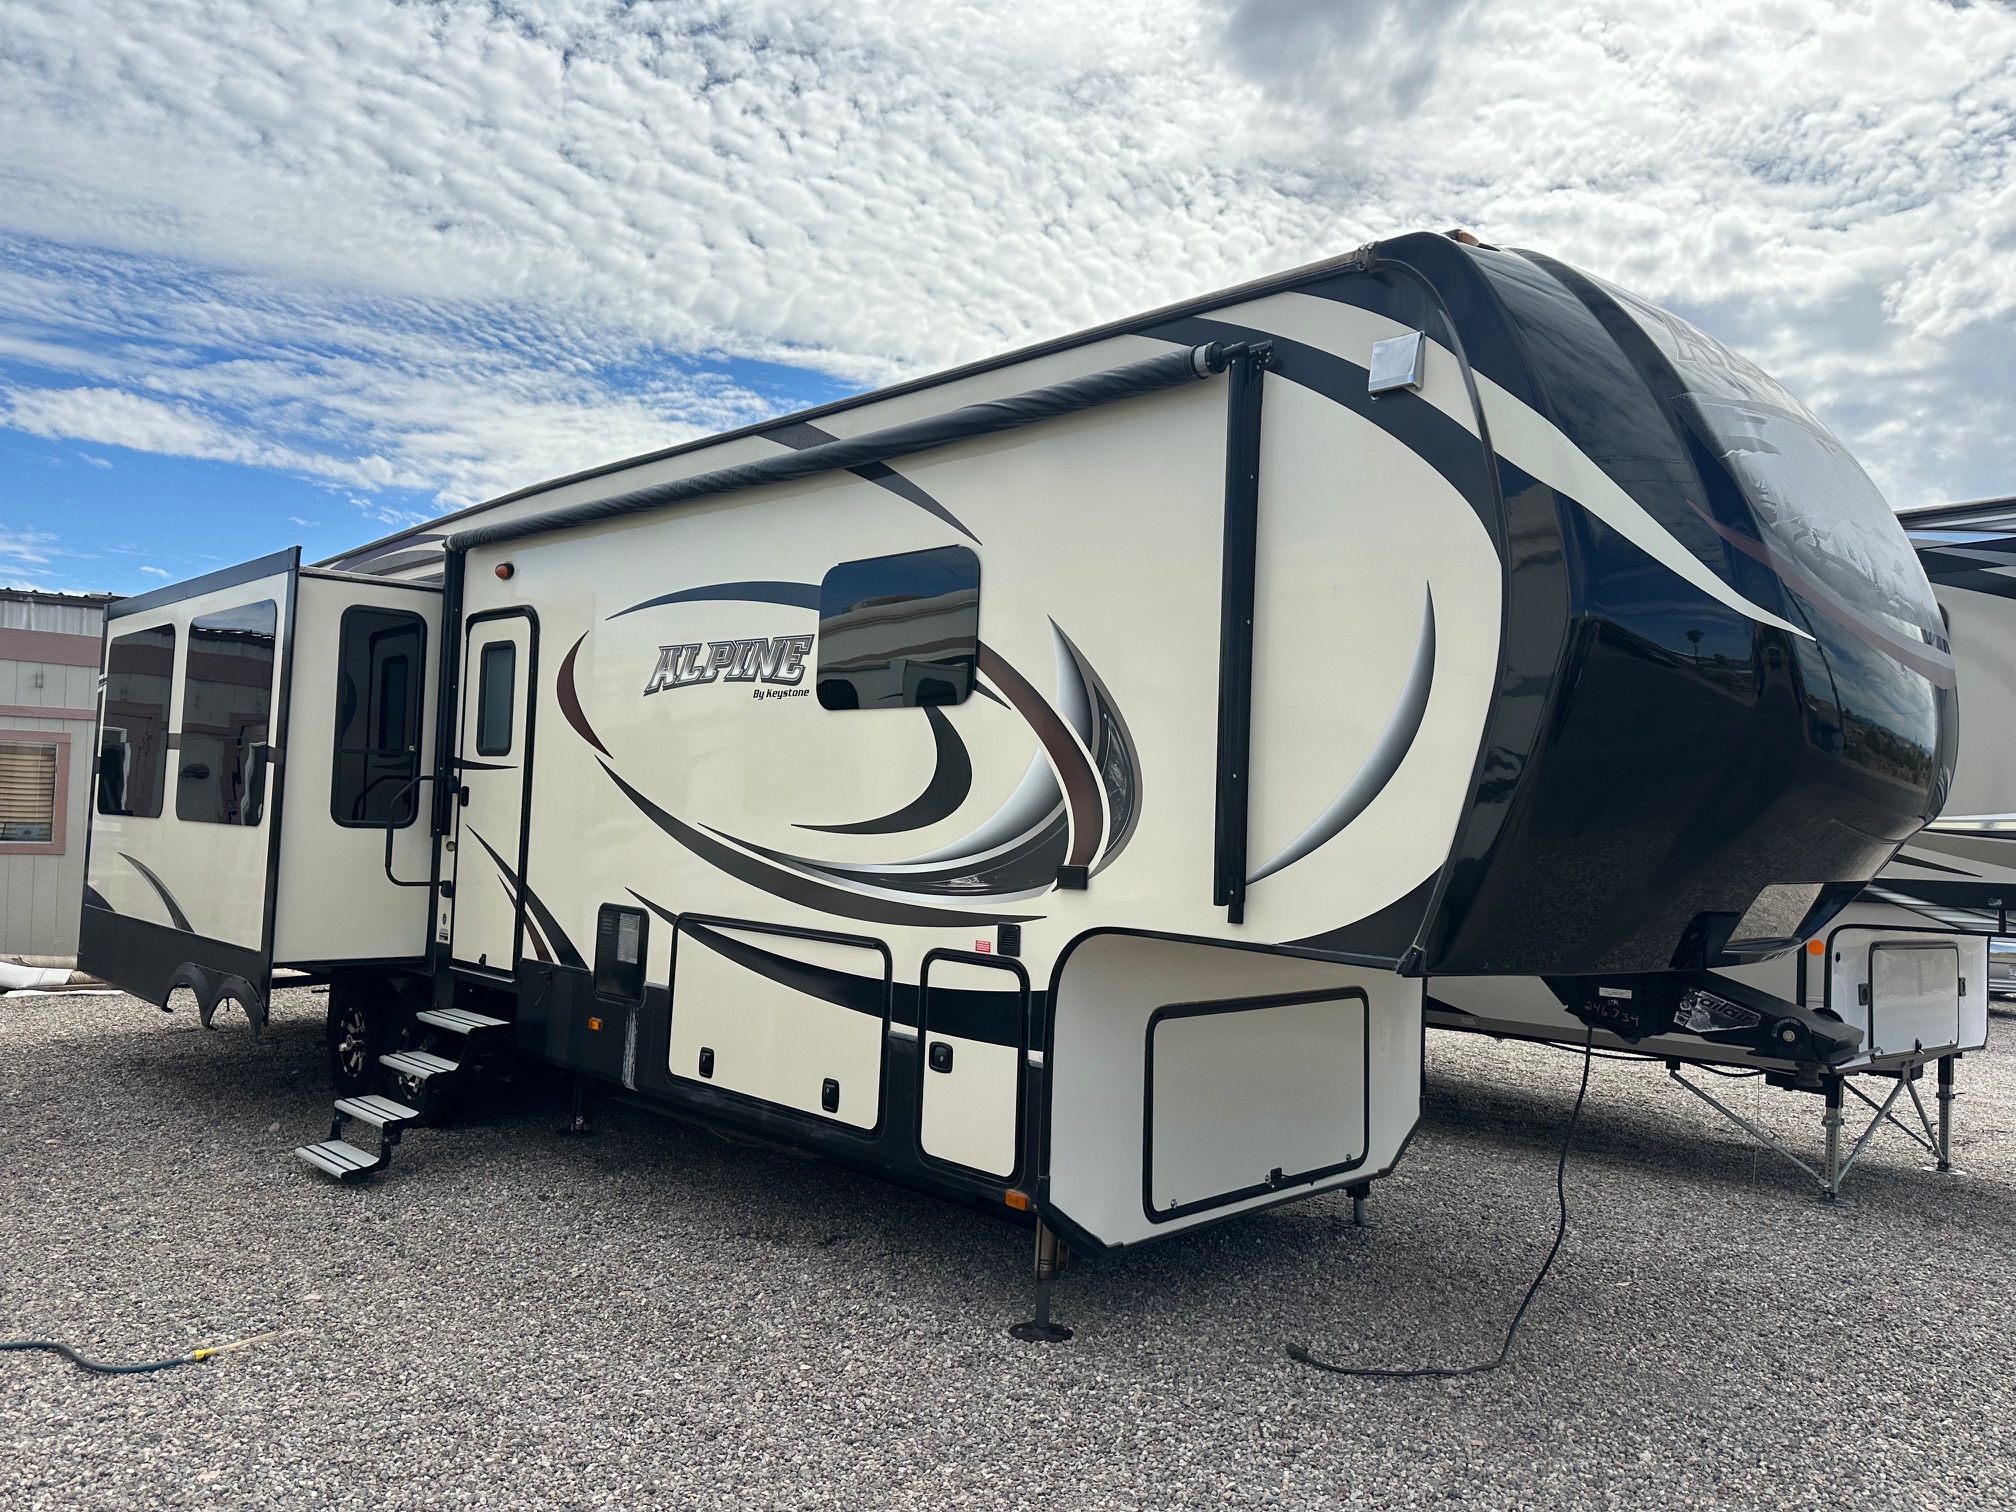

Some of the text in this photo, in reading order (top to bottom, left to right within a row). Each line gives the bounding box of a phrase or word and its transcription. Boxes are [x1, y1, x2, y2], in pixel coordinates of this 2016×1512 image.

[643, 634, 815, 697] ALPINE
[753, 688, 810, 700] By Keystone
